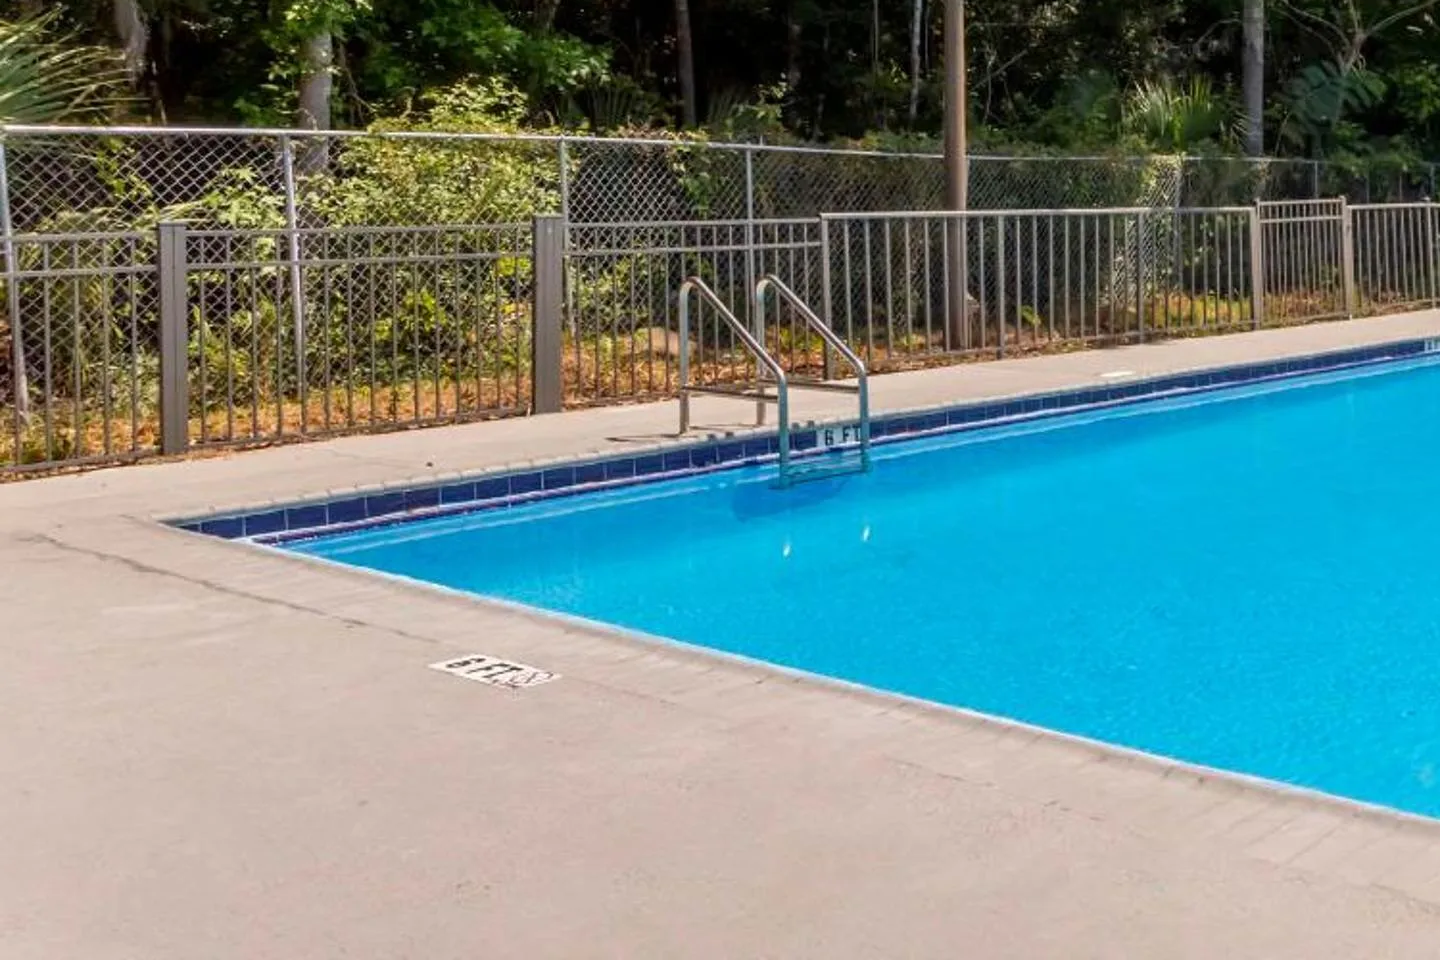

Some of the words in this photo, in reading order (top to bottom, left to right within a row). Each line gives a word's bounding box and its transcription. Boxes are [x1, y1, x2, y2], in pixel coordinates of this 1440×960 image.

[825, 429, 834, 446] 6
[843, 424, 861, 442] FT
[446, 657, 486, 668] 6
[466, 662, 525, 679] FT
